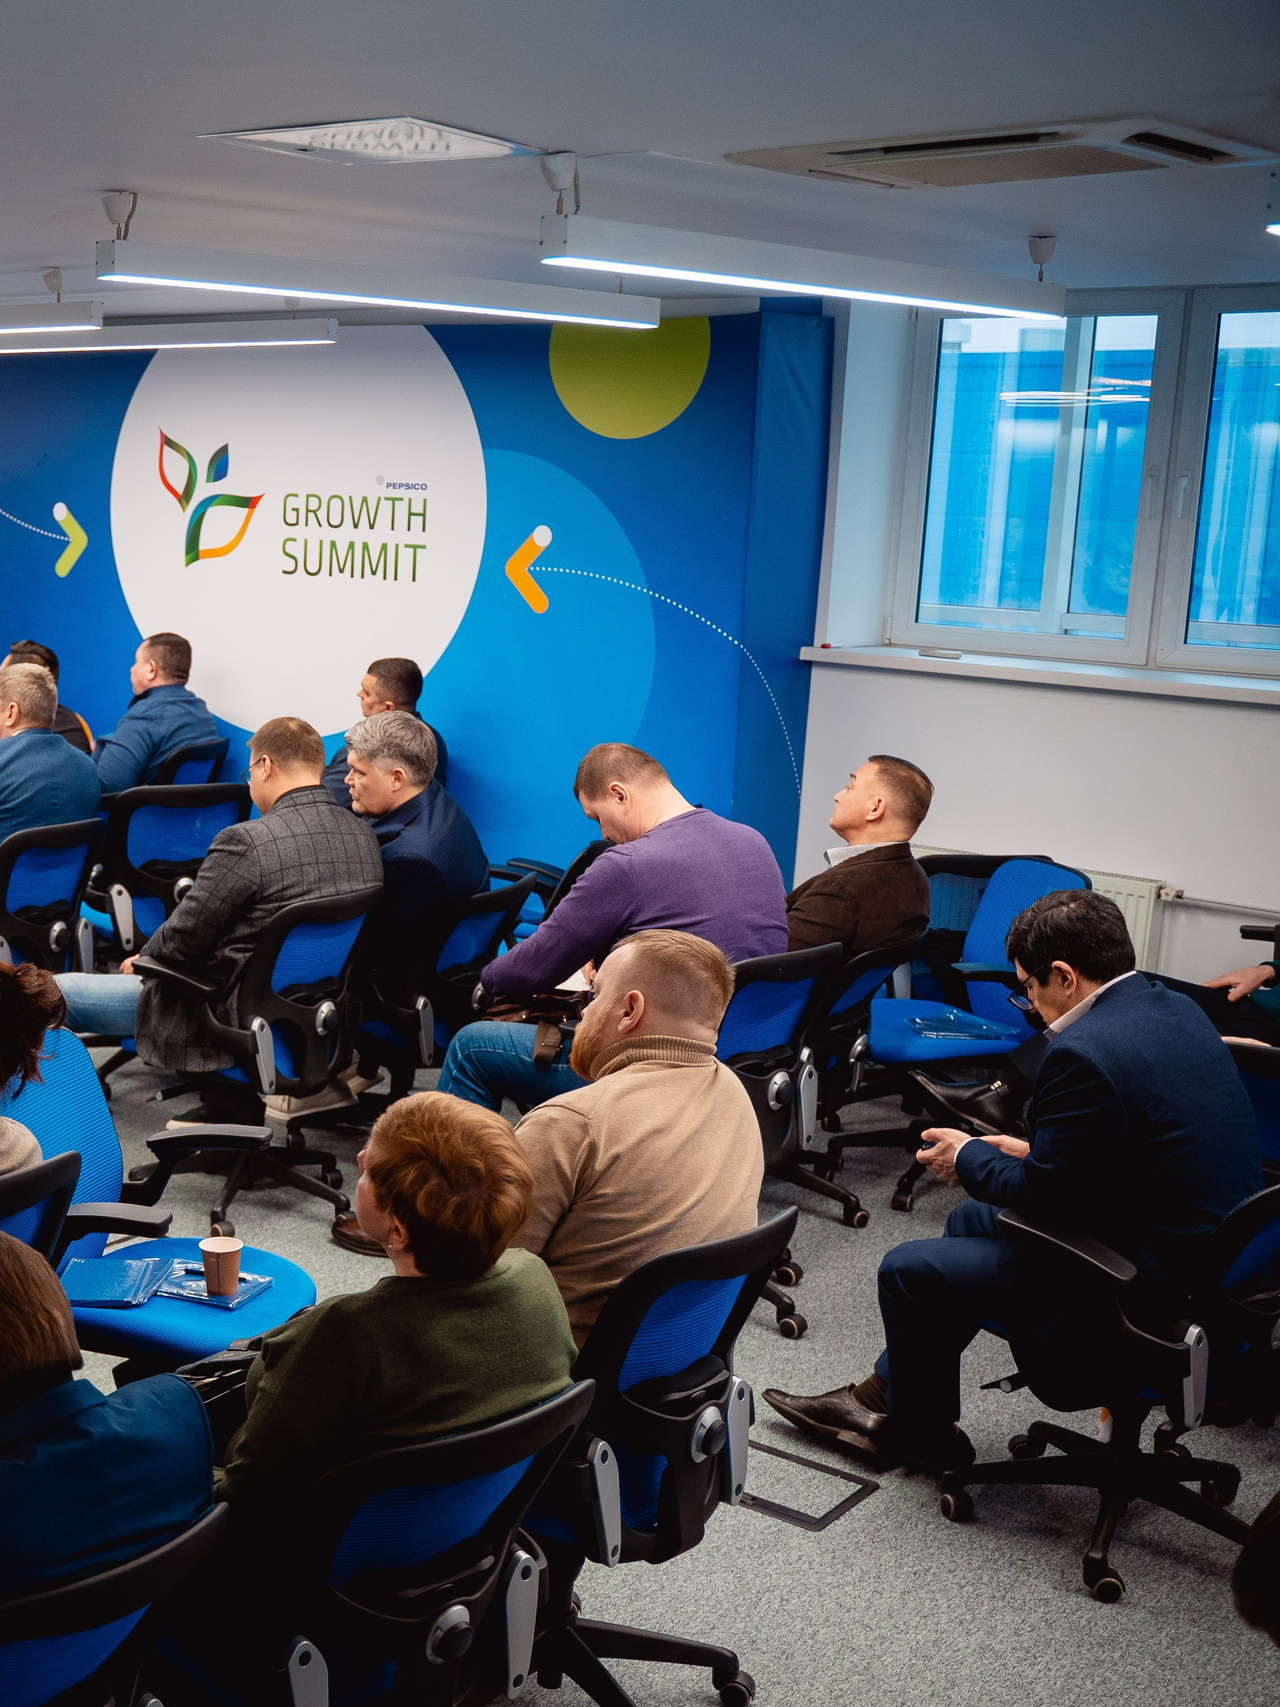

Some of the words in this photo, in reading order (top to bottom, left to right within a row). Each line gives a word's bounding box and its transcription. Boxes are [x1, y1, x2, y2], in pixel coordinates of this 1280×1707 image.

[385, 482, 428, 491] PEPSICO
[282, 493, 428, 533] GROWTH
[281, 537, 427, 583] SUMMIT
